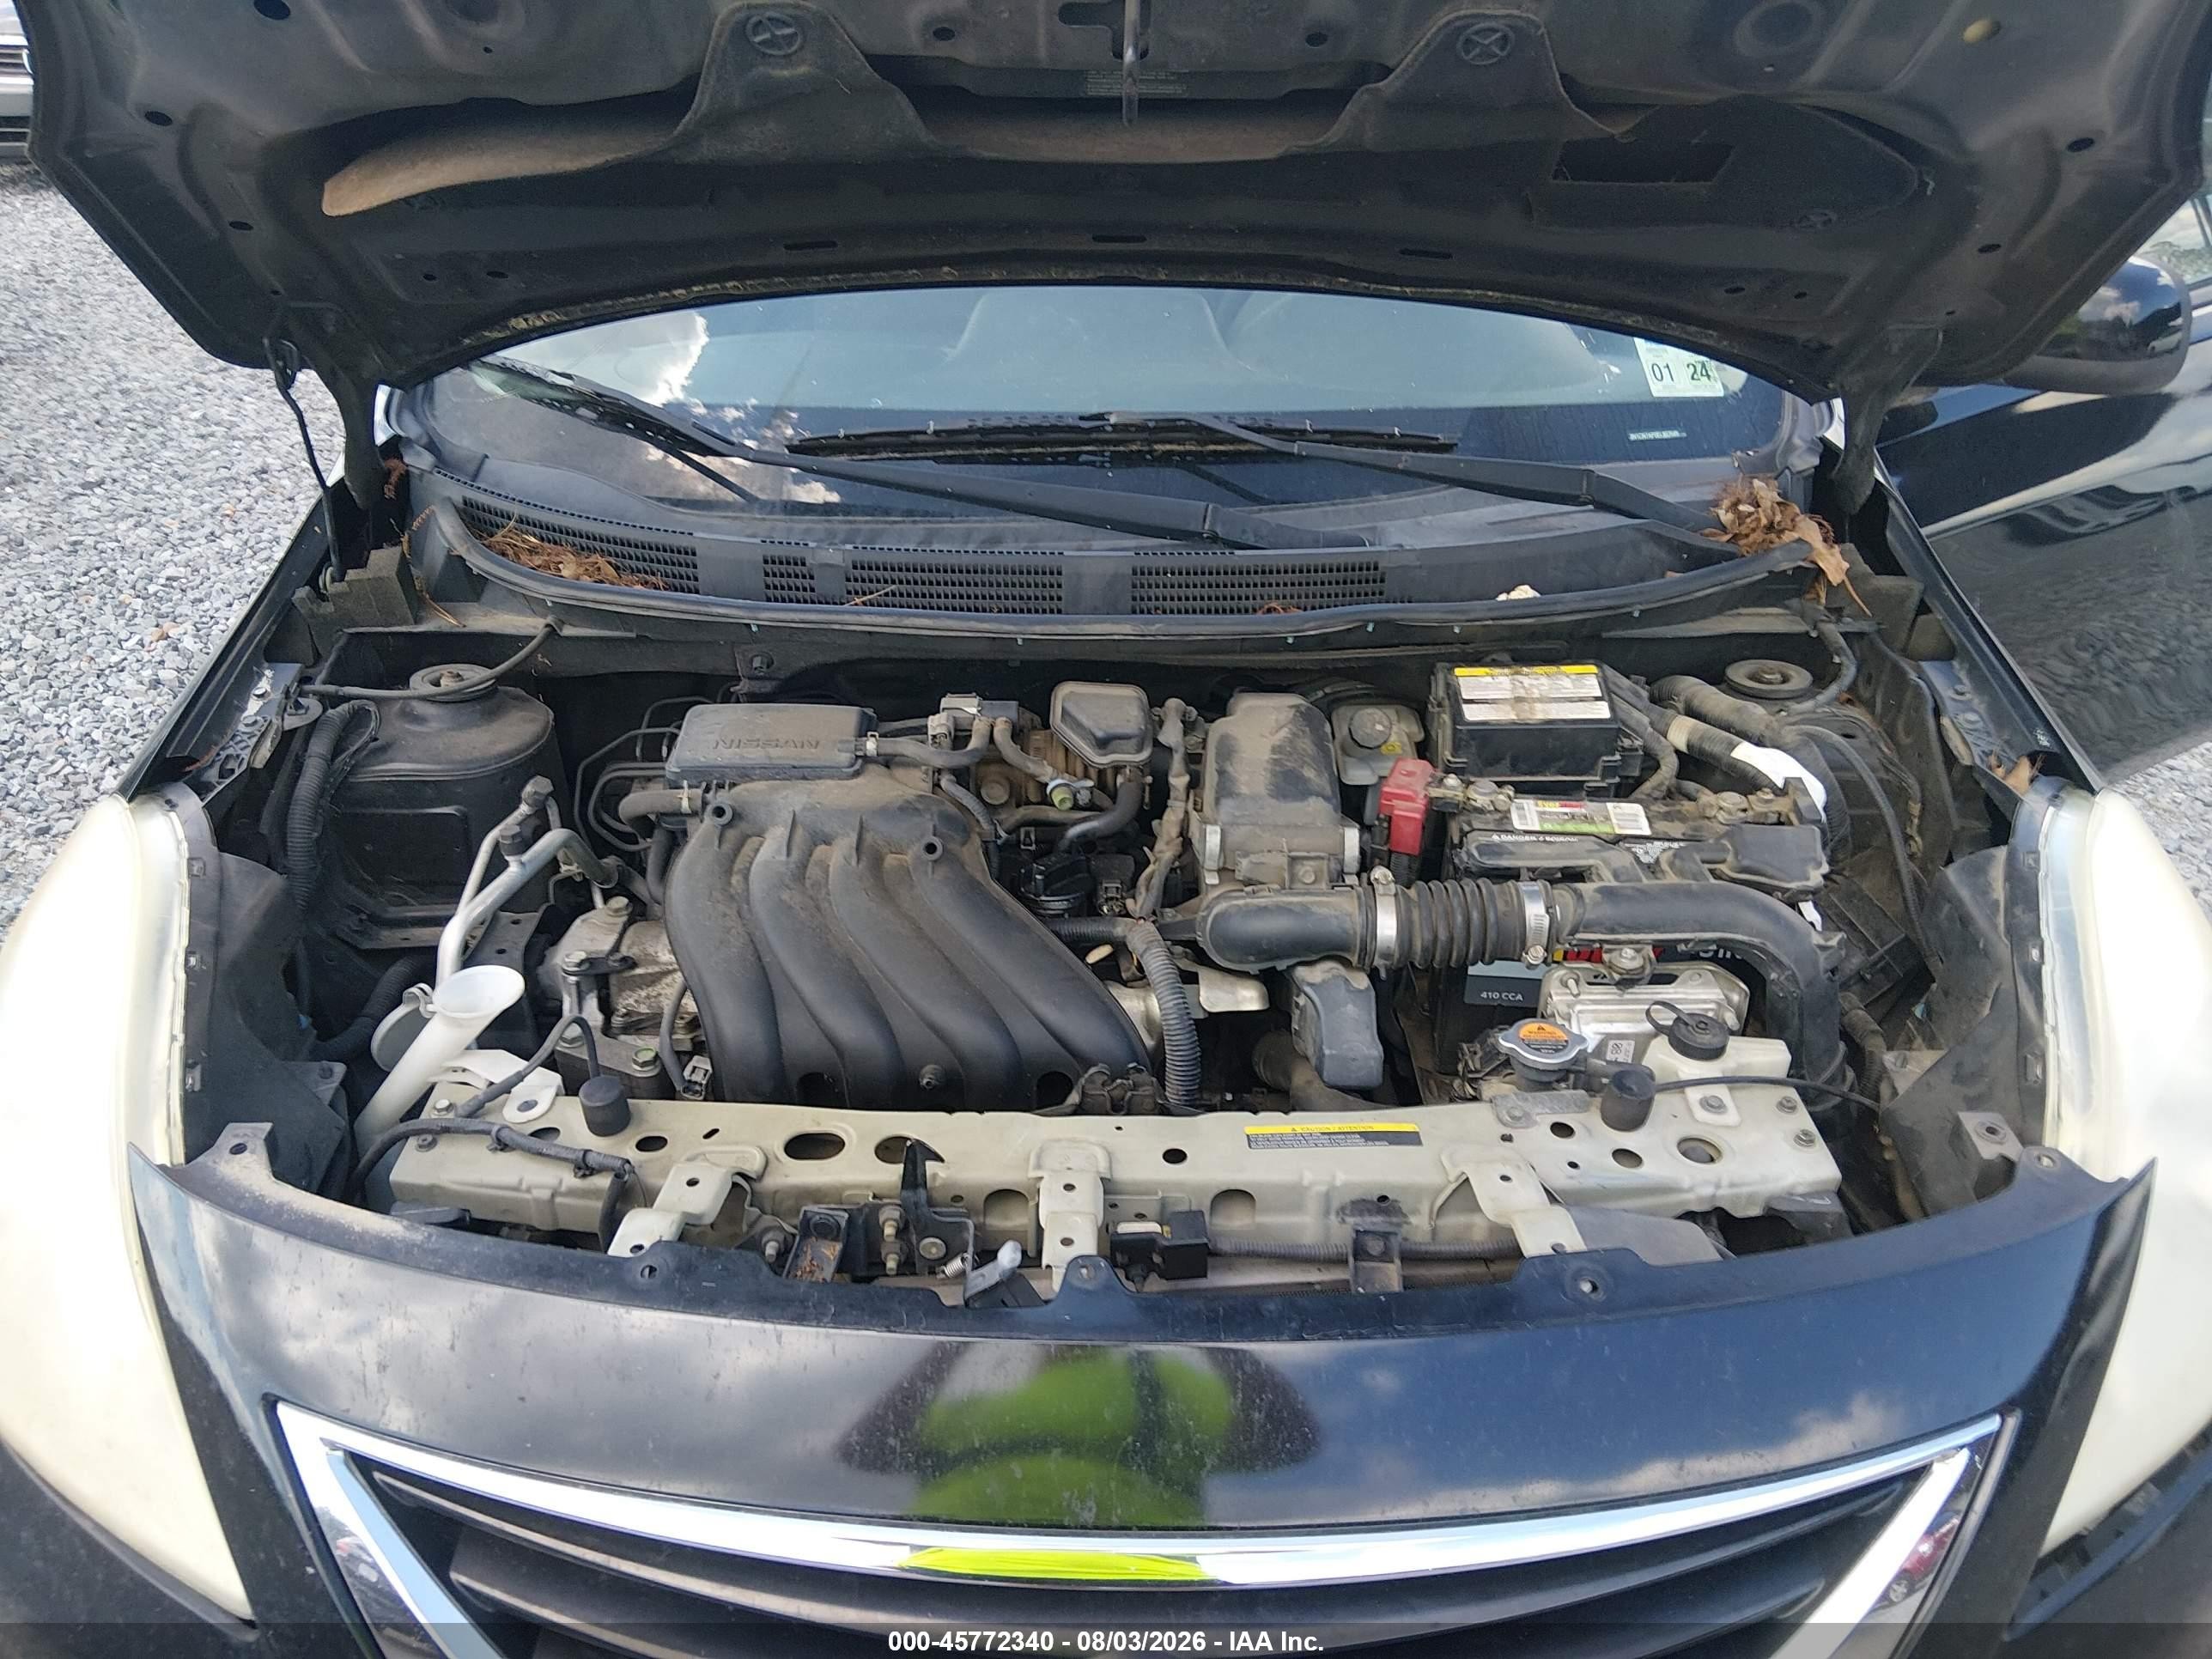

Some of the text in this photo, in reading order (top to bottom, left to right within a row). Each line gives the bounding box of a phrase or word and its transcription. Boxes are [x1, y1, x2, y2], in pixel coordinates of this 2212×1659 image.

[1650, 360, 1712, 382] 01 24
[713, 738, 821, 750] NISSAN
[1480, 991, 1524, 1002] 410 CCA
